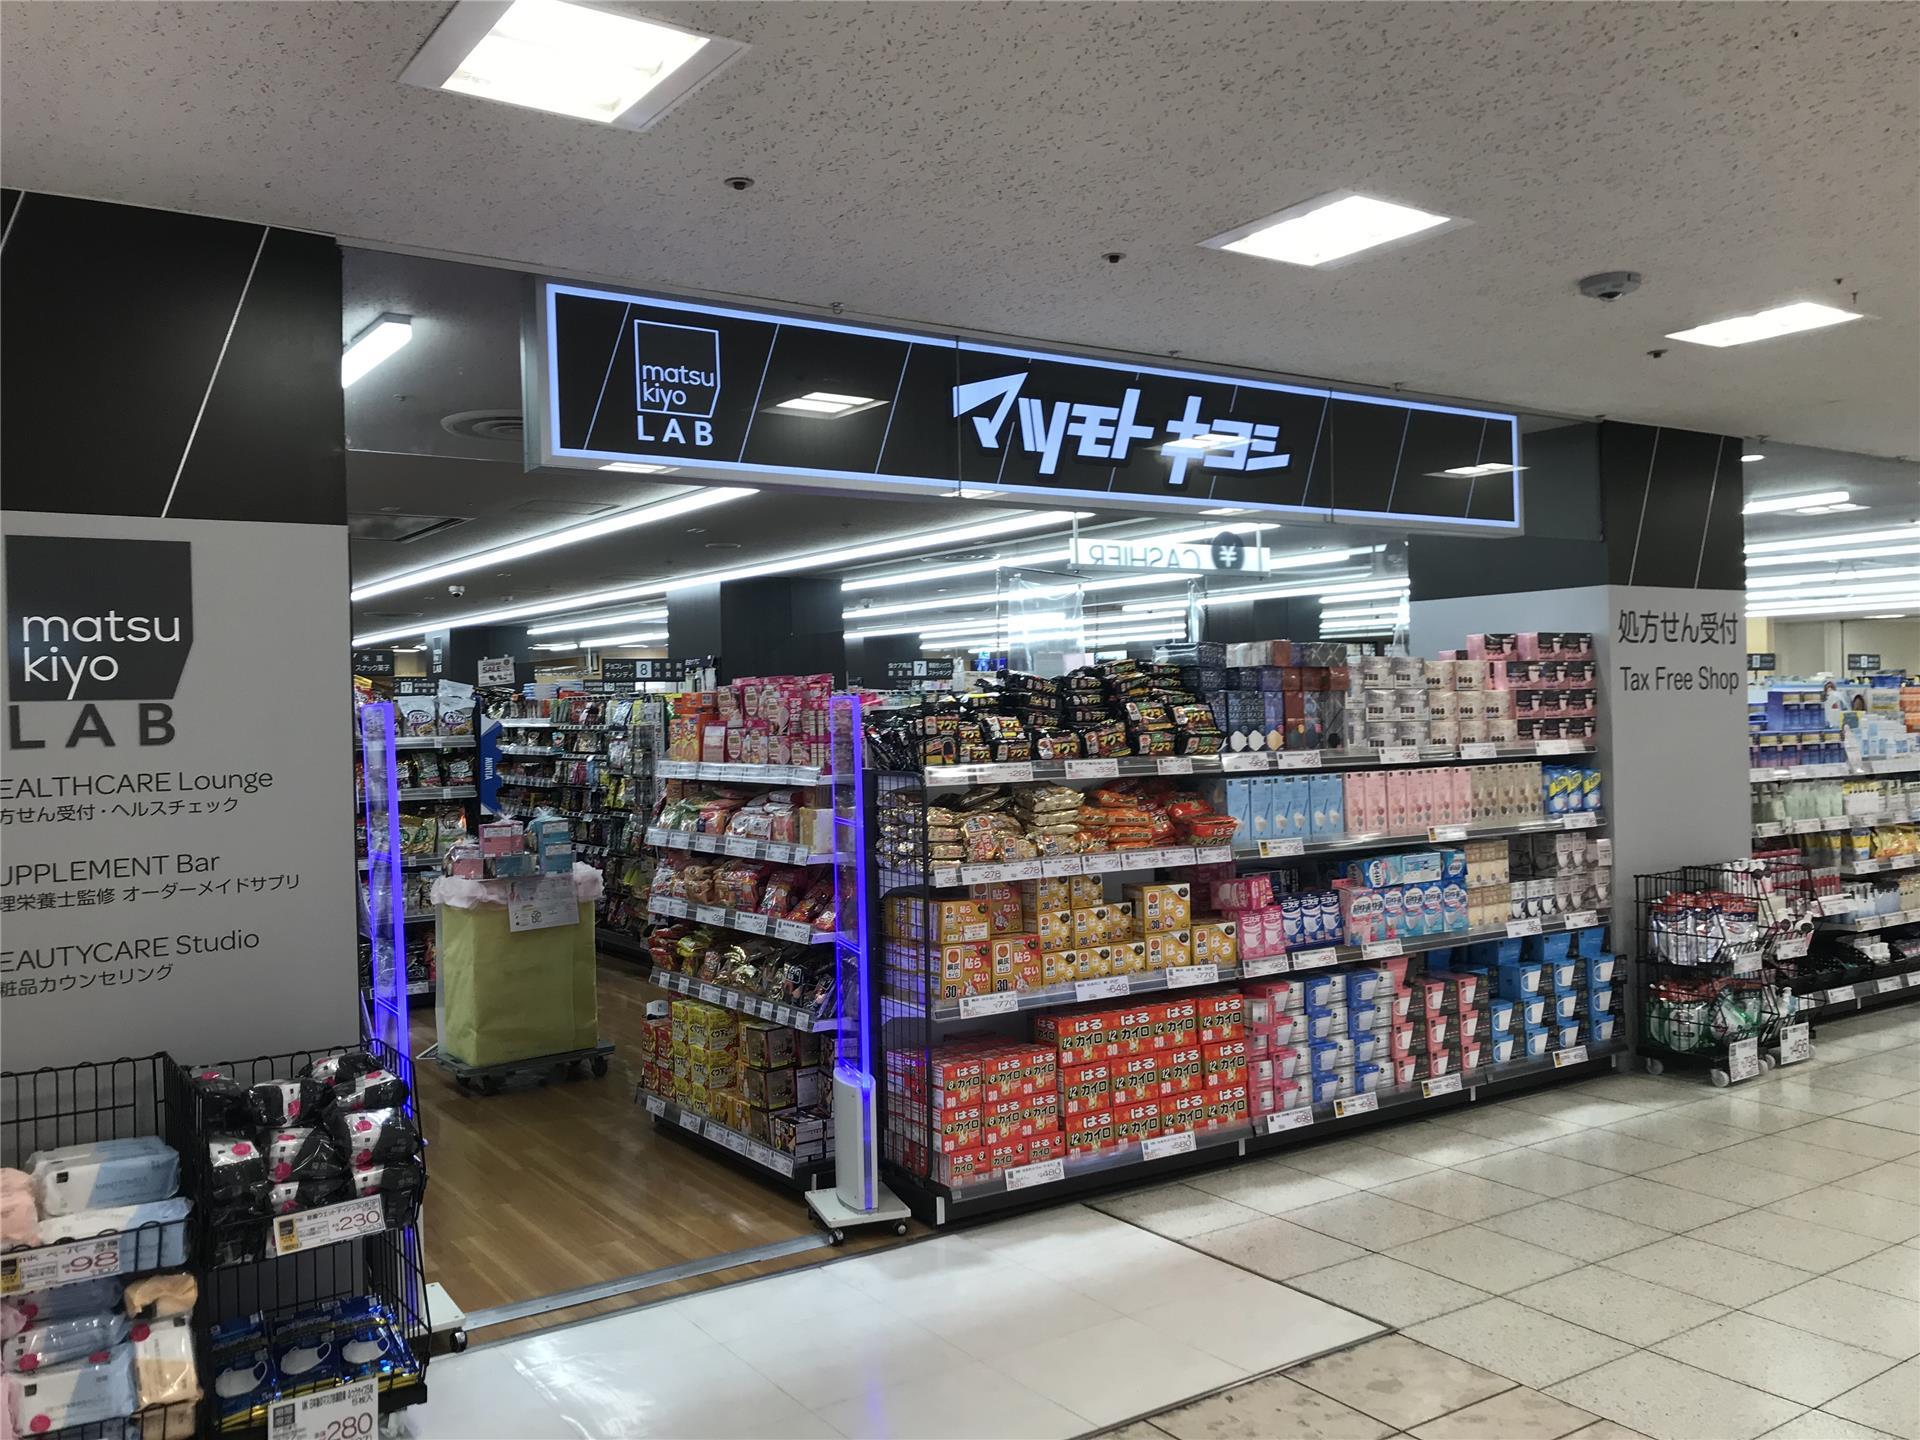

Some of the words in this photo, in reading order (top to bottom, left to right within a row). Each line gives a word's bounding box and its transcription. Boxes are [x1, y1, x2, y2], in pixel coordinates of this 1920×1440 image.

[642, 365, 715, 387] matsu
[643, 382, 687, 412] kiyo
[637, 415, 714, 446] LAB
[22, 610, 181, 642] matsu
[1618, 609, 1739, 645] 処方せん受付
[23, 646, 120, 701] kiyo
[640, 663, 648, 676] 8
[917, 663, 923, 674] 7
[1619, 666, 1650, 691] Tax
[1655, 666, 1694, 691] Free
[1699, 665, 1740, 695] Shop
[9, 702, 176, 750] LAB
[179, 771, 273, 793] Lounge
[177, 853, 220, 873] Bar
[123, 874, 300, 902] オーダーメイドサプリ
[175, 930, 260, 955] Studio
[964, 957, 982, 969] 貼ら
[1013, 951, 1031, 963] 貼ら
[973, 972, 989, 982] ない
[1023, 966, 1040, 975] ない
[945, 985, 957, 998] 30
[996, 979, 1008, 992] 30
[1109, 983, 1128, 993] 648
[1167, 1005, 1194, 1018] はる
[1215, 999, 1241, 1012] はる
[1075, 1019, 1102, 1032] はる
[1120, 1012, 1149, 1025] はる
[1203, 1017, 1212, 1028] 12
[1215, 1012, 1241, 1025] カイロ
[1155, 1023, 1164, 1034] 12
[1167, 1018, 1194, 1032] カイロ
[1063, 1038, 1073, 1049] 12
[1075, 1031, 1102, 1047] カイロ
[1107, 1031, 1117, 1042] 12
[1122, 1026, 1149, 1040] カイロ
[1173, 1050, 1199, 1063] はる
[1220, 1043, 1245, 1056] はる
[998, 1060, 1020, 1071] はる
[1033, 1053, 1055, 1065] はる
[1128, 1058, 1155, 1072] はる
[1208, 1061, 1217, 1072] 12
[1221, 1056, 1245, 1070] カイロ
[956, 1066, 980, 1077] はる
[988, 1075, 997, 1084] 8
[999, 1070, 1020, 1082] カイロ
[1024, 1068, 1032, 1076] 8
[1034, 1064, 1054, 1074] カイロ
[1081, 1067, 1107, 1081] はる
[1161, 1069, 1171, 1080] 12
[1174, 1063, 1199, 1077] カイロ
[947, 1081, 955, 1090] 8
[958, 1076, 980, 1088] カイロ
[1116, 1077, 1126, 1089] 12
[1129, 1072, 1155, 1086] カイロ
[1069, 1087, 1078, 1099] 12
[1082, 1081, 1107, 1096] カイロ
[1219, 1087, 1245, 1100] はる
[997, 1101, 1019, 1113] はる
[1033, 1095, 1056, 1106] はる
[1176, 1096, 1203, 1109] はる
[955, 1109, 979, 1120] はる
[1022, 1109, 1031, 1118] 8
[1033, 1106, 1056, 1116] カイロ
[1130, 1105, 1158, 1119] はる
[1208, 1105, 1217, 1116] 12
[1221, 1101, 1244, 1114] カイロ
[988, 1117, 996, 1126] 8
[998, 1113, 1019, 1124] カイロ
[1083, 1114, 1111, 1128] はる
[1165, 1115, 1174, 1126] 12
[1178, 1109, 1202, 1123] カイロ
[945, 1125, 953, 1134] 8
[956, 1120, 979, 1132] カイロ
[1118, 1124, 1128, 1136] 12
[1132, 1119, 1157, 1133] カイロ
[1070, 1134, 1080, 1145] 12
[1084, 1128, 1111, 1143] カイロ
[1032, 1140, 1049, 1148] はる
[993, 1147, 1012, 1156] はる
[1032, 1148, 1049, 1157] カイロ
[954, 1154, 973, 1164] はる
[994, 1156, 1012, 1165] カイロ
[954, 1164, 972, 1173] カイロ
[340, 1210, 381, 1231] 230
[70, 1251, 119, 1272] 98
[327, 1412, 373, 1440] 280
